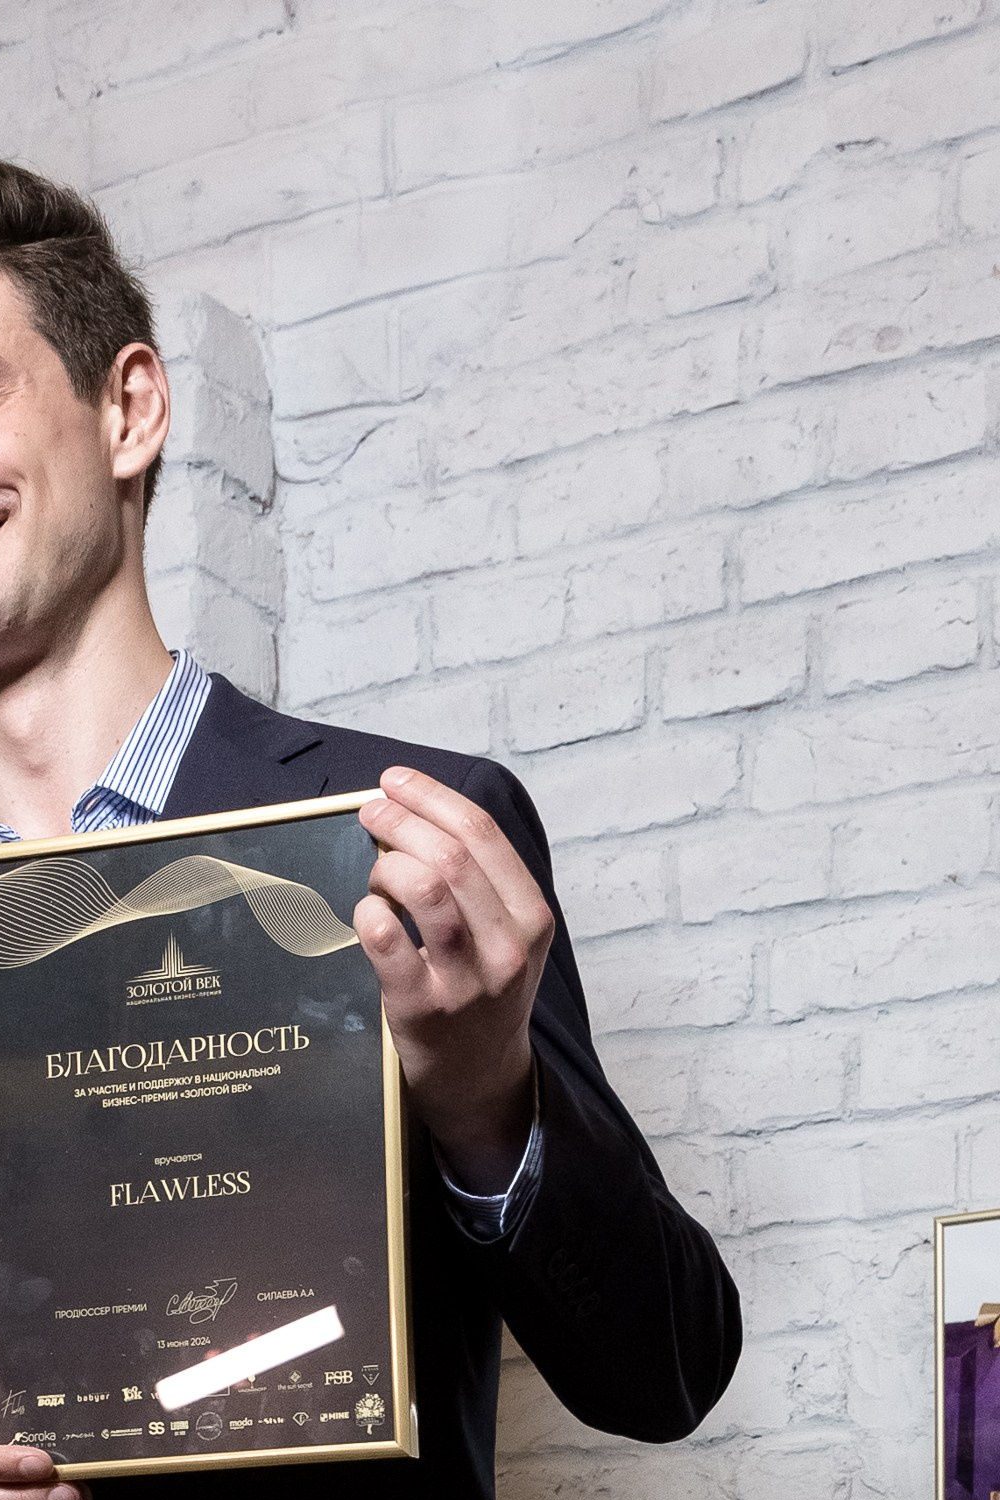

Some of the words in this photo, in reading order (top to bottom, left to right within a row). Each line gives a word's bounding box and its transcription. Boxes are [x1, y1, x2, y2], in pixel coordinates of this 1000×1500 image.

[126, 977, 192, 998] ЗОЛОТОЙ
[196, 975, 221, 990] ВЕК
[46, 1024, 310, 1079] БЛАГОДАРНОСТЬ
[74, 1089, 87, 1098] ЗА
[88, 1083, 128, 1097] УЧАСТИЕ
[129, 1082, 136, 1091] И
[137, 1075, 193, 1091] ПОДДЕРЖКУ
[195, 1075, 202, 1083] В
[203, 1064, 281, 1083] НАЦИОНАЛЬНОЙ
[102, 1091, 179, 1108] БИЗНЕС-ПРЕМИИ
[180, 1084, 230, 1099] «ЗОЛОТОЙ
[231, 1082, 252, 1093] ВЕК»
[154, 1153, 203, 1166] вручается
[110, 1170, 251, 1207] FLAWLESS
[256, 1289, 299, 1301] СИЛАЕВА
[55, 1306, 111, 1319] ПРОДЮССЕР
[112, 1303, 147, 1315] ПРЕМИИ
[157, 1340, 166, 1349] 13
[166, 1339, 189, 1349] июня
[190, 1336, 211, 1347] 2024
[324, 1370, 353, 1386] FSB
[37, 1397, 65, 1407] ВОДА
[329, 1411, 350, 1420] MINE
[22, 1430, 56, 1443] Soroka
